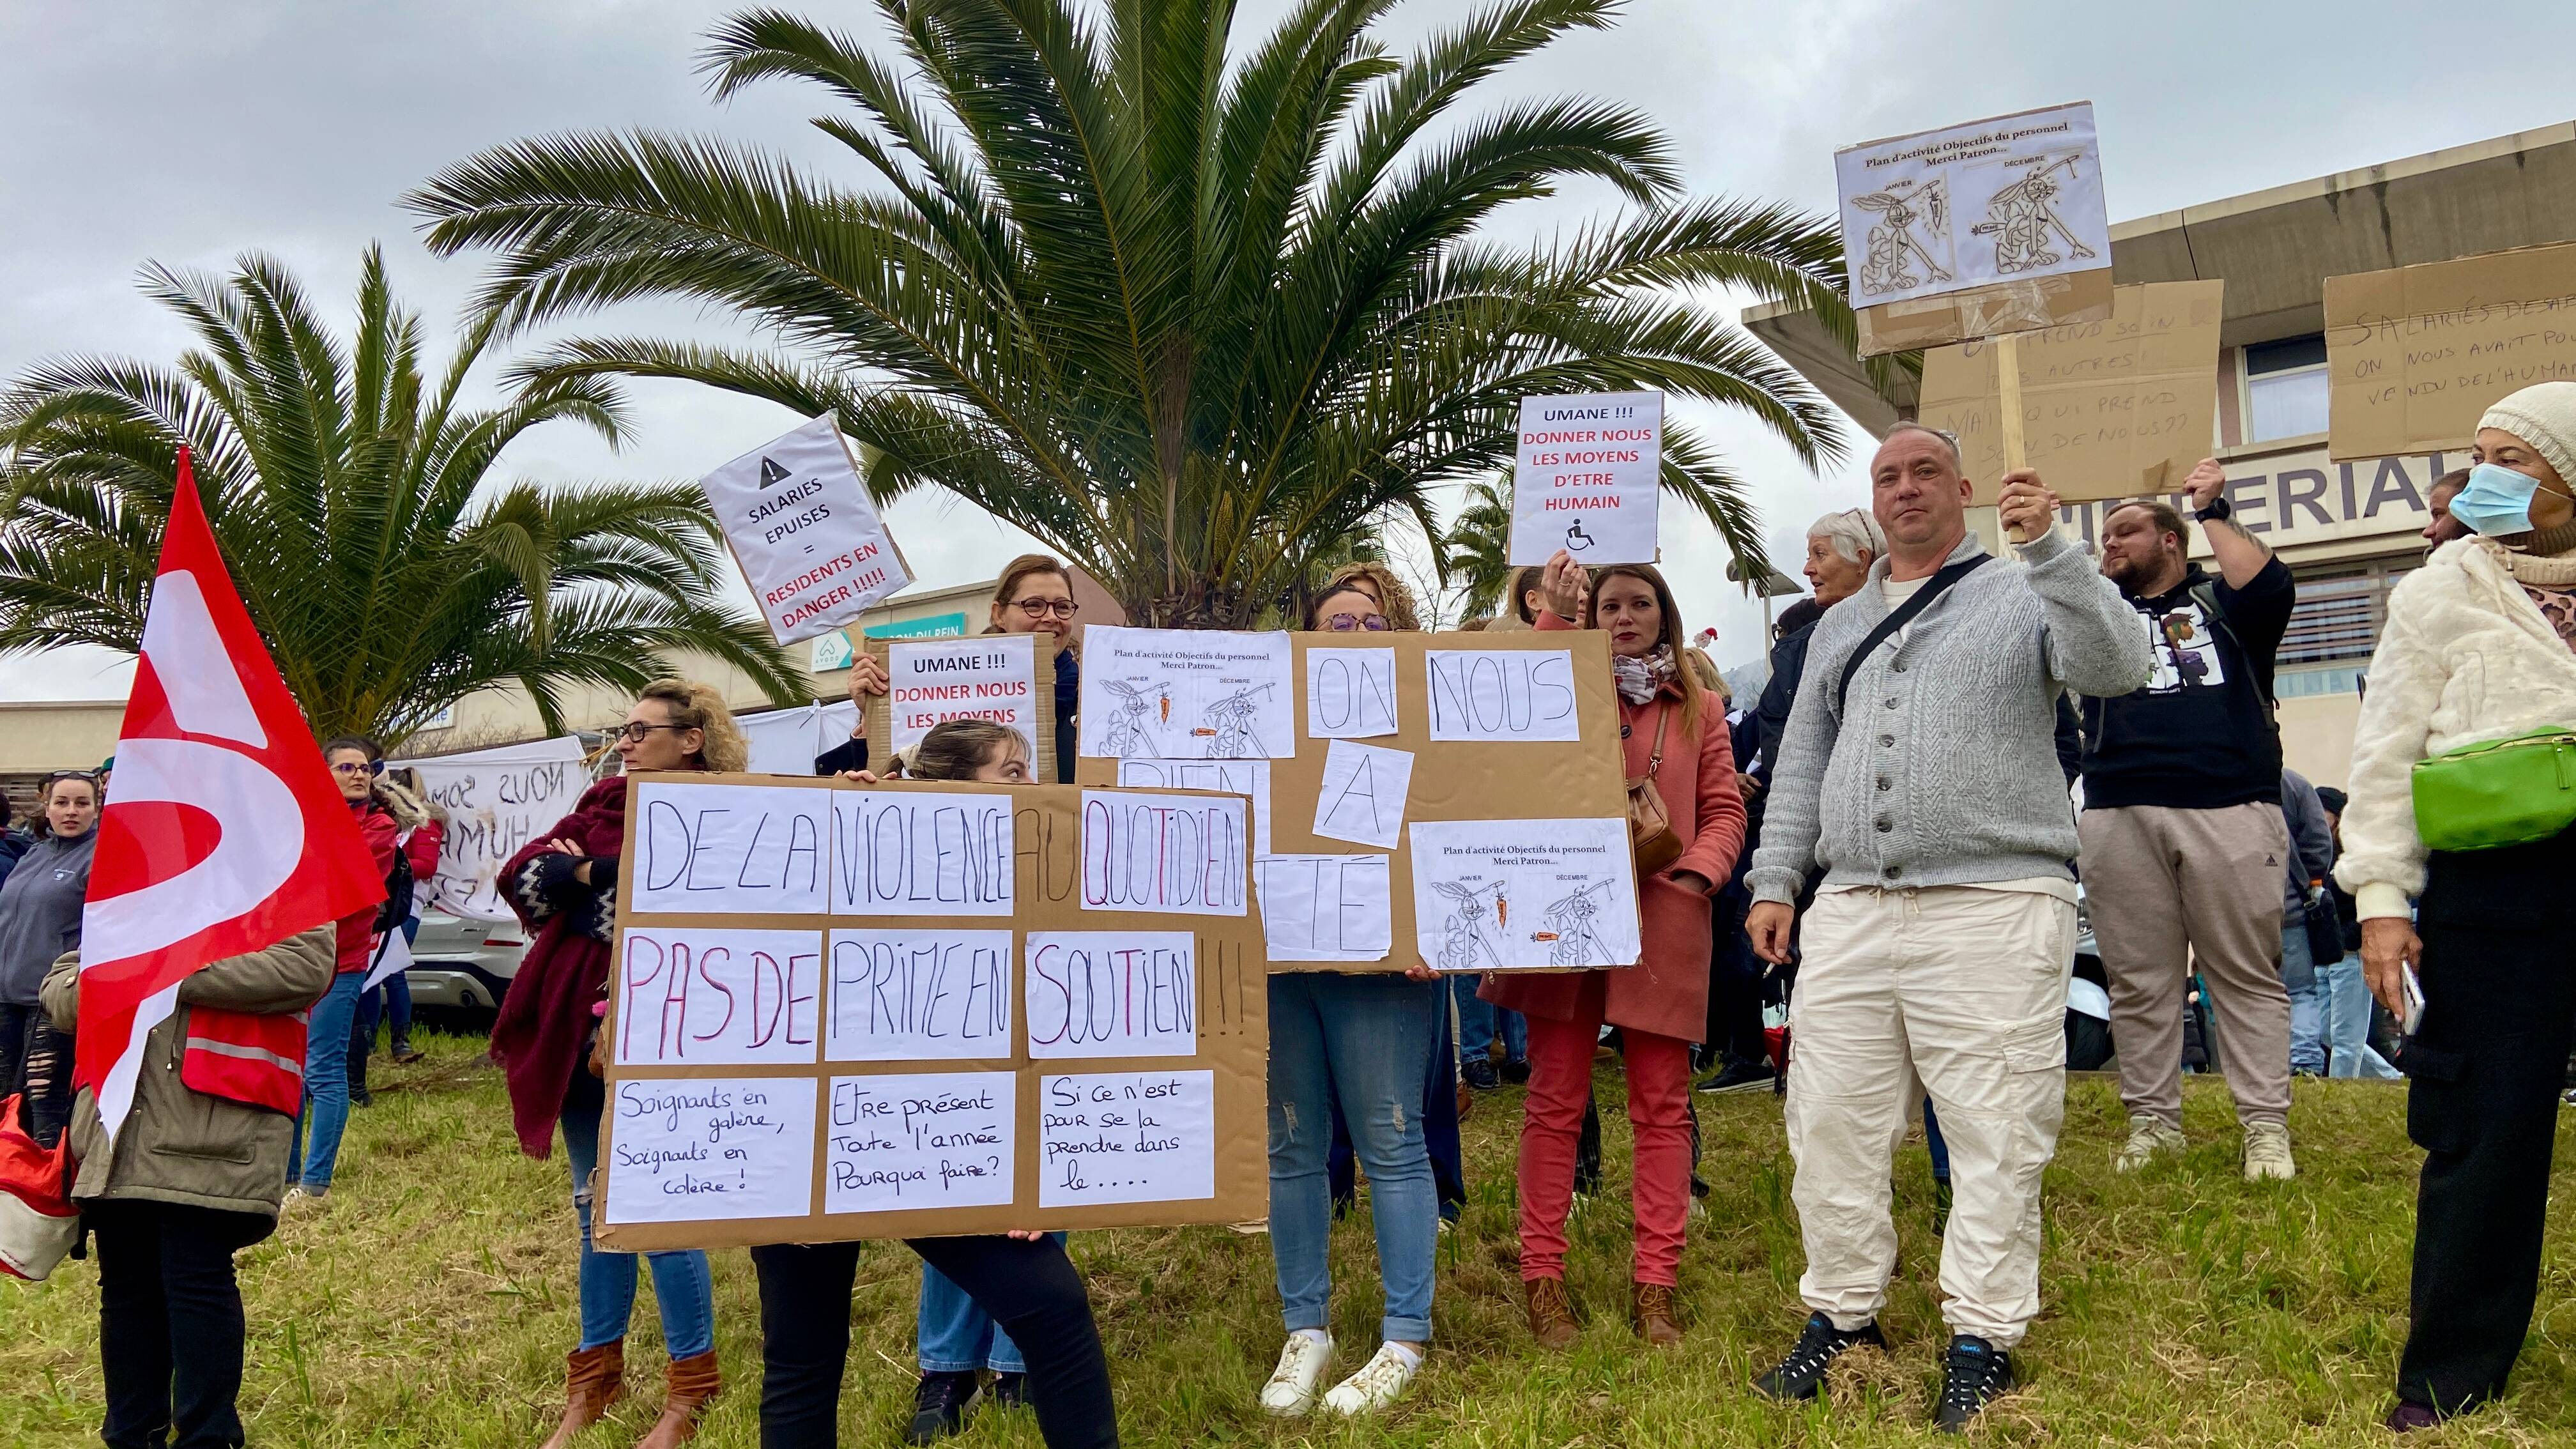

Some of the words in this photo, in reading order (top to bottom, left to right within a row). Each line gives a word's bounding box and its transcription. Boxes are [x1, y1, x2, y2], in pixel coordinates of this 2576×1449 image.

[1866, 157, 1890, 167] Plan
[1892, 144, 1940, 163] d'activité
[1943, 135, 1993, 153] Objectifs
[1995, 131, 2009, 142] du
[2012, 123, 2068, 141] personnel
[1926, 153, 1958, 167] Merci
[1959, 147, 2007, 162] Patron...
[1884, 180, 1912, 191] JANVIER
[2356, 358, 2382, 379] ON
[2407, 347, 2455, 366] NOUS
[2368, 379, 2448, 405] VENDU
[1544, 408, 1609, 421] UMANE
[1615, 406, 1634, 418] !!!
[2098, 392, 2177, 414] PREND
[1523, 431, 1597, 445] DONNER
[1602, 429, 1652, 441] NOUS
[2052, 433, 2089, 449] DE
[1533, 453, 1560, 466] LES
[1565, 450, 1639, 464] MOYENS
[1554, 473, 1614, 487] D'ETRE
[748, 477, 823, 524] SALARIES
[1545, 495, 1620, 510] HUMAIN
[765, 503, 831, 544] EPUISES
[766, 554, 852, 607] RESIDENTS
[854, 542, 879, 563] EN
[781, 585, 852, 629] DANGER
[935, 625, 959, 637] REIN
[914, 656, 981, 673] UMANE
[987, 654, 1006, 669] !!!
[1114, 649, 1133, 658] Plan
[1135, 650, 1174, 659] d'activité
[1175, 651, 1213, 662] Objectifs
[1227, 653, 1270, 663] personnel
[895, 684, 970, 703] DONNER
[976, 680, 1027, 698] NOUS
[1317, 657, 1395, 730] ON
[1429, 656, 1572, 733] NOUS
[907, 713, 935, 729] LES
[1323, 753, 1381, 834] A
[647, 800, 731, 891] DE
[738, 811, 817, 893] LA
[1014, 808, 1076, 903] AU
[1443, 847, 1463, 855] Plan
[1466, 845, 1505, 855] d'activité
[1506, 845, 1547, 855] Objectifs
[1549, 845, 1560, 854] du
[1562, 845, 1606, 855] personnel
[1493, 857, 1519, 866] Merci
[623, 935, 735, 1061] PAS
[746, 951, 820, 1049] DE
[962, 947, 1009, 1039] EN
[1052, 1077, 1082, 1107] Si
[1124, 1077, 1183, 1100] n'est
[621, 1082, 732, 1131] Soignants
[742, 1089, 768, 1105] en
[1138, 1108, 1161, 1128] la
[1134, 1130, 1181, 1151] dans
[616, 1141, 708, 1174] Soignants
[724, 1148, 748, 1161] en
